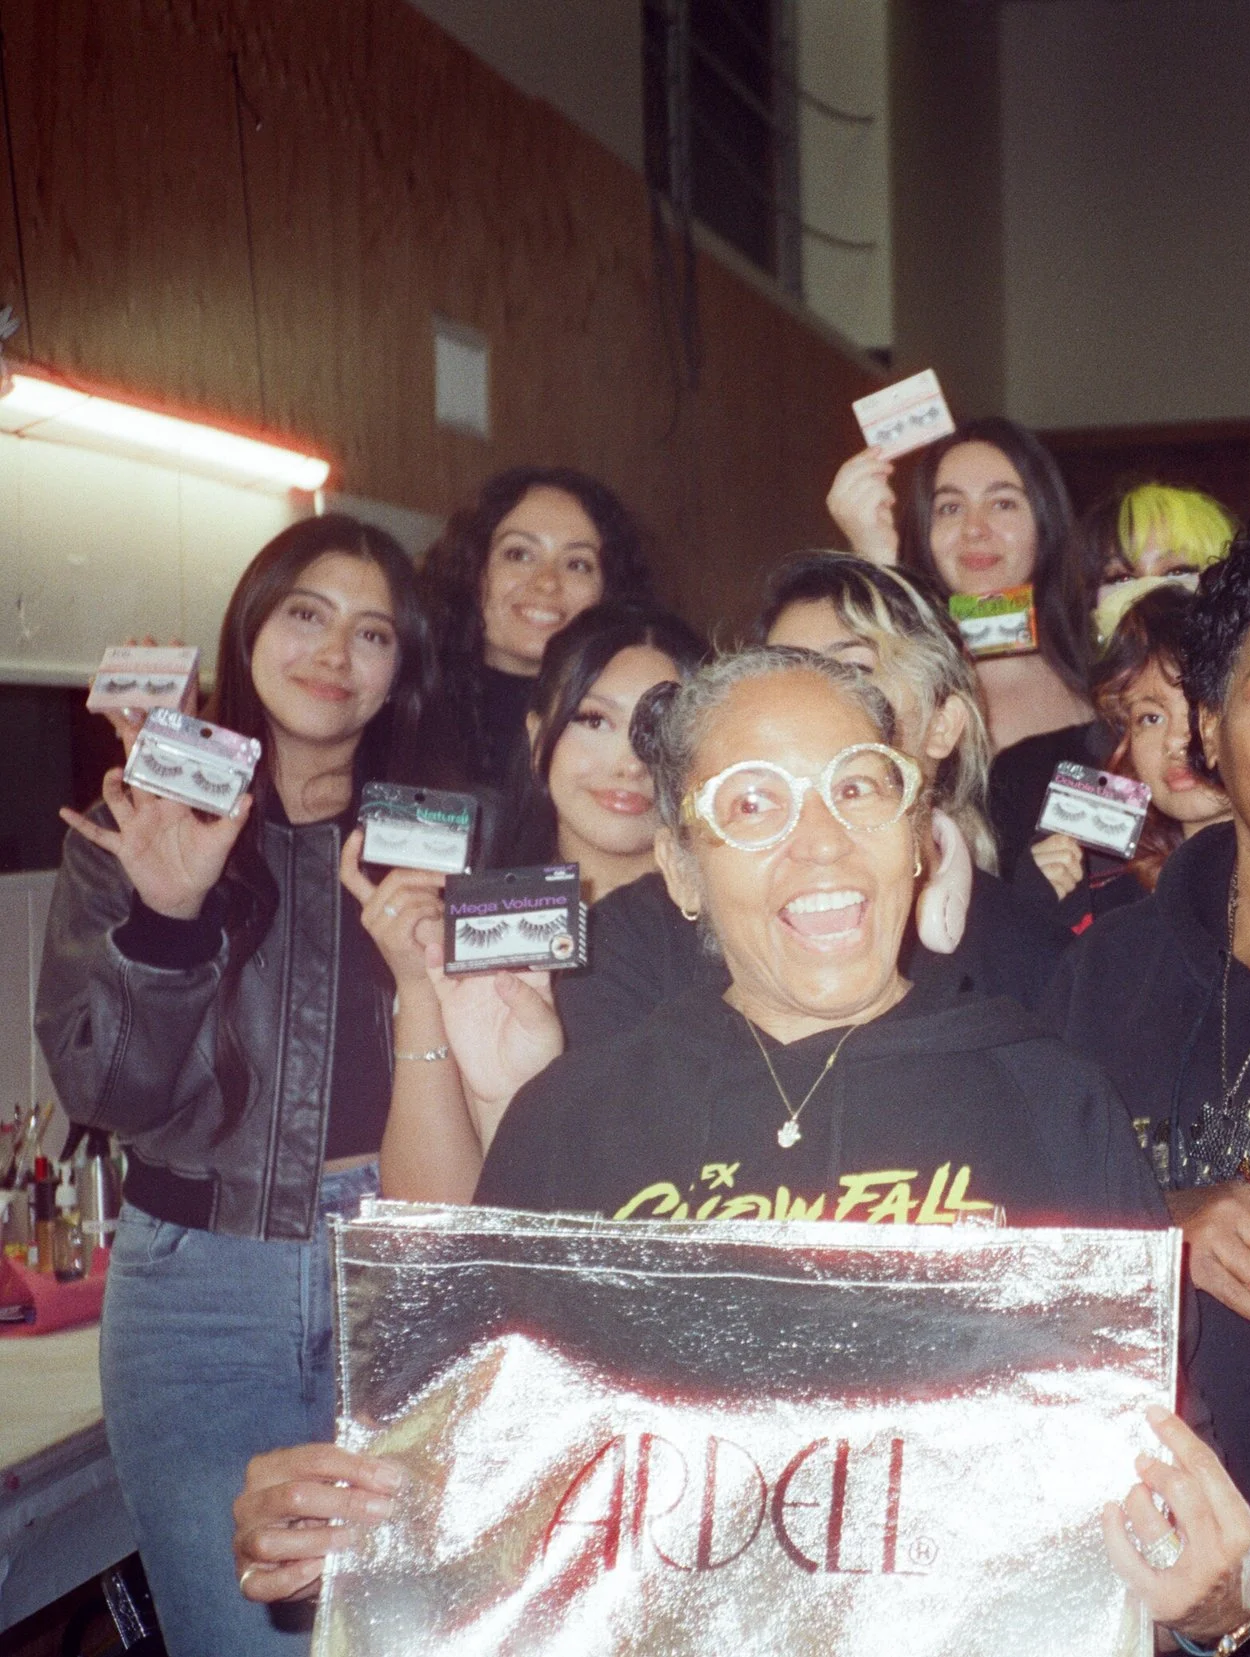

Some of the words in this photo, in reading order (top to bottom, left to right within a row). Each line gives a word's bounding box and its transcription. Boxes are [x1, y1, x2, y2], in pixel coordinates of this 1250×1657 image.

[416, 807, 470, 826] Natural
[450, 902, 498, 916] Mega
[502, 895, 568, 910] Volume
[702, 1161, 741, 1190] FX
